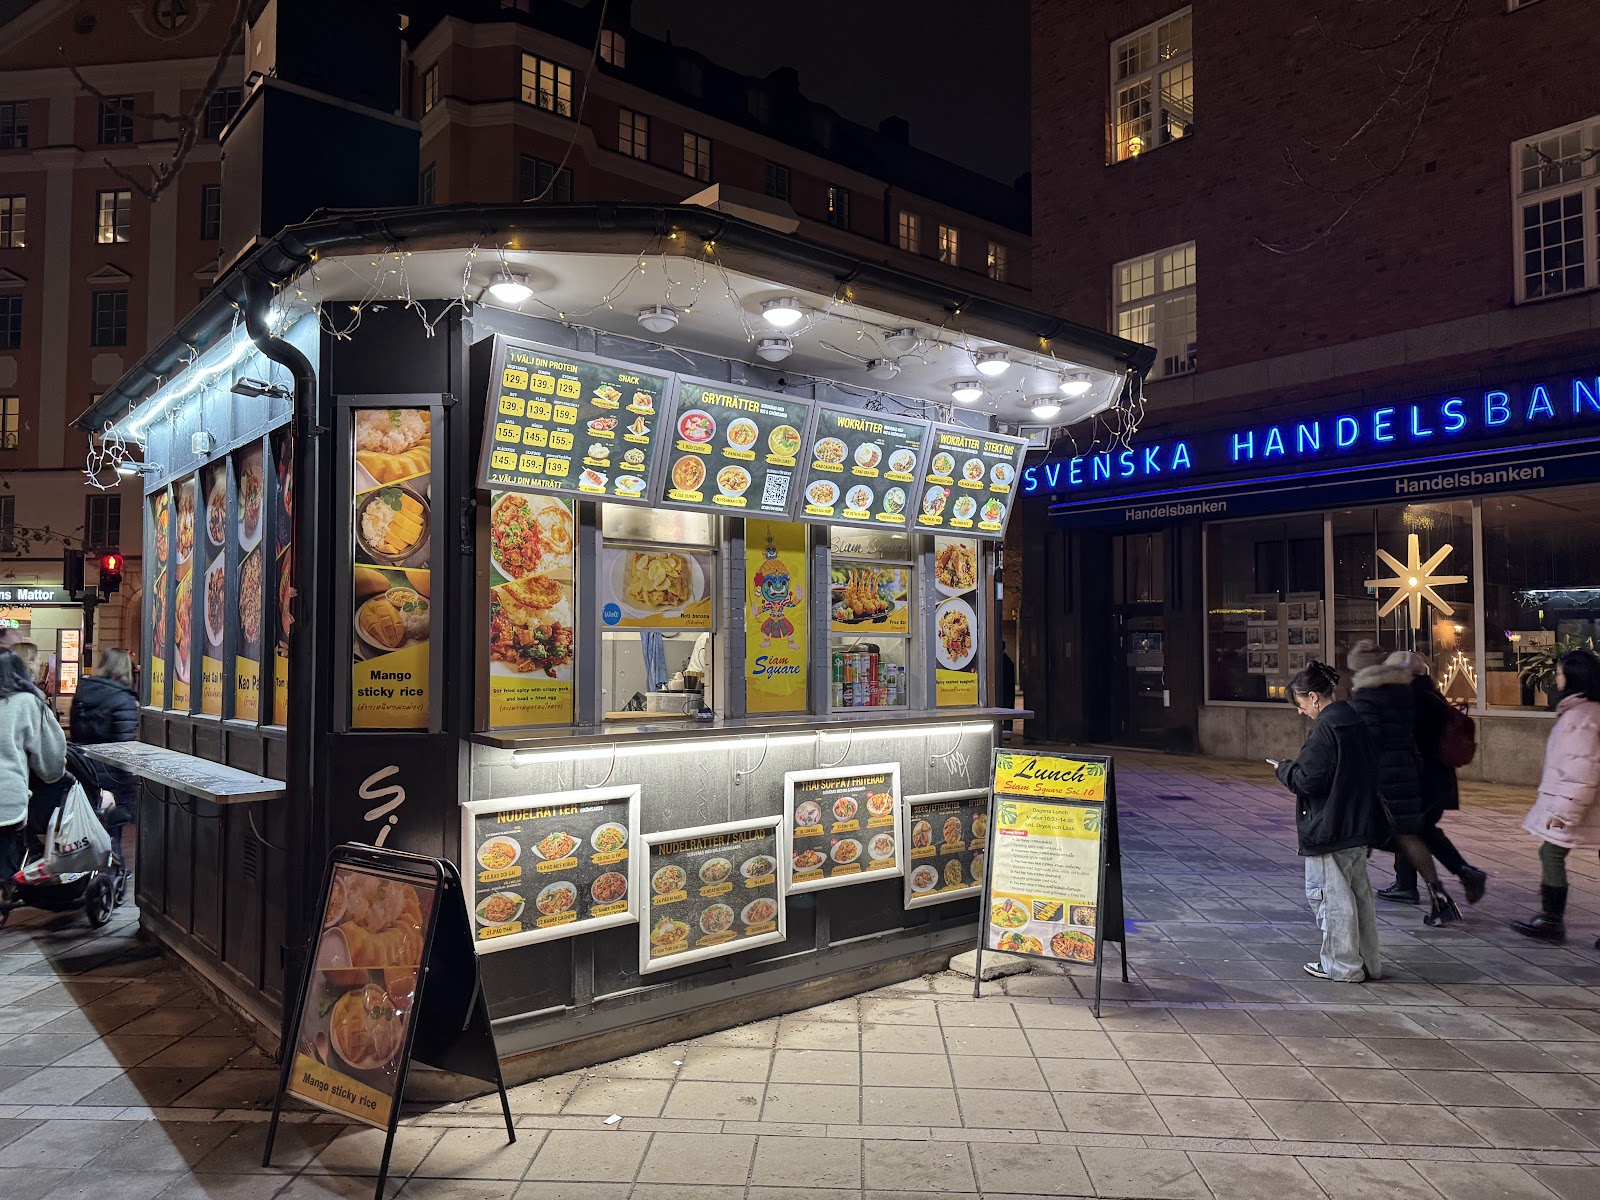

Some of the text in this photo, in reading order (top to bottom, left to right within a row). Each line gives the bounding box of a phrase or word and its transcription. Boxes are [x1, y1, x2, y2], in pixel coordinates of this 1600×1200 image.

[535, 358, 548, 368] DIN
[549, 360, 579, 373] PROTEIN
[505, 373, 527, 385] 129.-
[533, 378, 553, 389] 139.-
[618, 374, 640, 385] SNACK
[559, 383, 579, 394] 129.-
[502, 401, 523, 412] 139.-
[701, 391, 760, 413] GRYTRÄTTER
[530, 405, 550, 416] 139.-
[555, 409, 575, 420] 159.-
[837, 416, 883, 434] WOKRÄTTER
[498, 427, 519, 438] 155.-
[525, 431, 546, 442] 145.-
[552, 435, 572, 446] 155.-
[940, 434, 980, 450] WOKRÄTTER
[984, 441, 1003, 453] STEKT
[1004, 445, 1015, 455] RIS
[494, 455, 515, 466] 145.-
[522, 459, 542, 469] 159.-
[1024, 442, 1191, 491] SVENSKA
[548, 462, 567, 472] 139.-
[517, 477, 530, 485] DIN
[531, 478, 563, 489] MATRÄTT
[1394, 464, 1545, 494] Handelsbanken
[1125, 500, 1227, 521] Handelsbanken
[17, 589, 55, 600] Mattor
[370, 670, 412, 682] Mango
[238, 675, 250, 690] Kao
[357, 687, 424, 698] sticky rice
[1013, 759, 1086, 783] Lunch
[801, 781, 819, 792] THAI
[820, 778, 846, 790] SOPPA
[852, 775, 885, 787] FRITERAD
[1004, 780, 1030, 792] Siam
[1034, 783, 1062, 794] Square
[1066, 787, 1080, 795] Soi
[732, 829, 766, 844] SALLAD
[302, 1072, 377, 1110] Mango sticky rice
